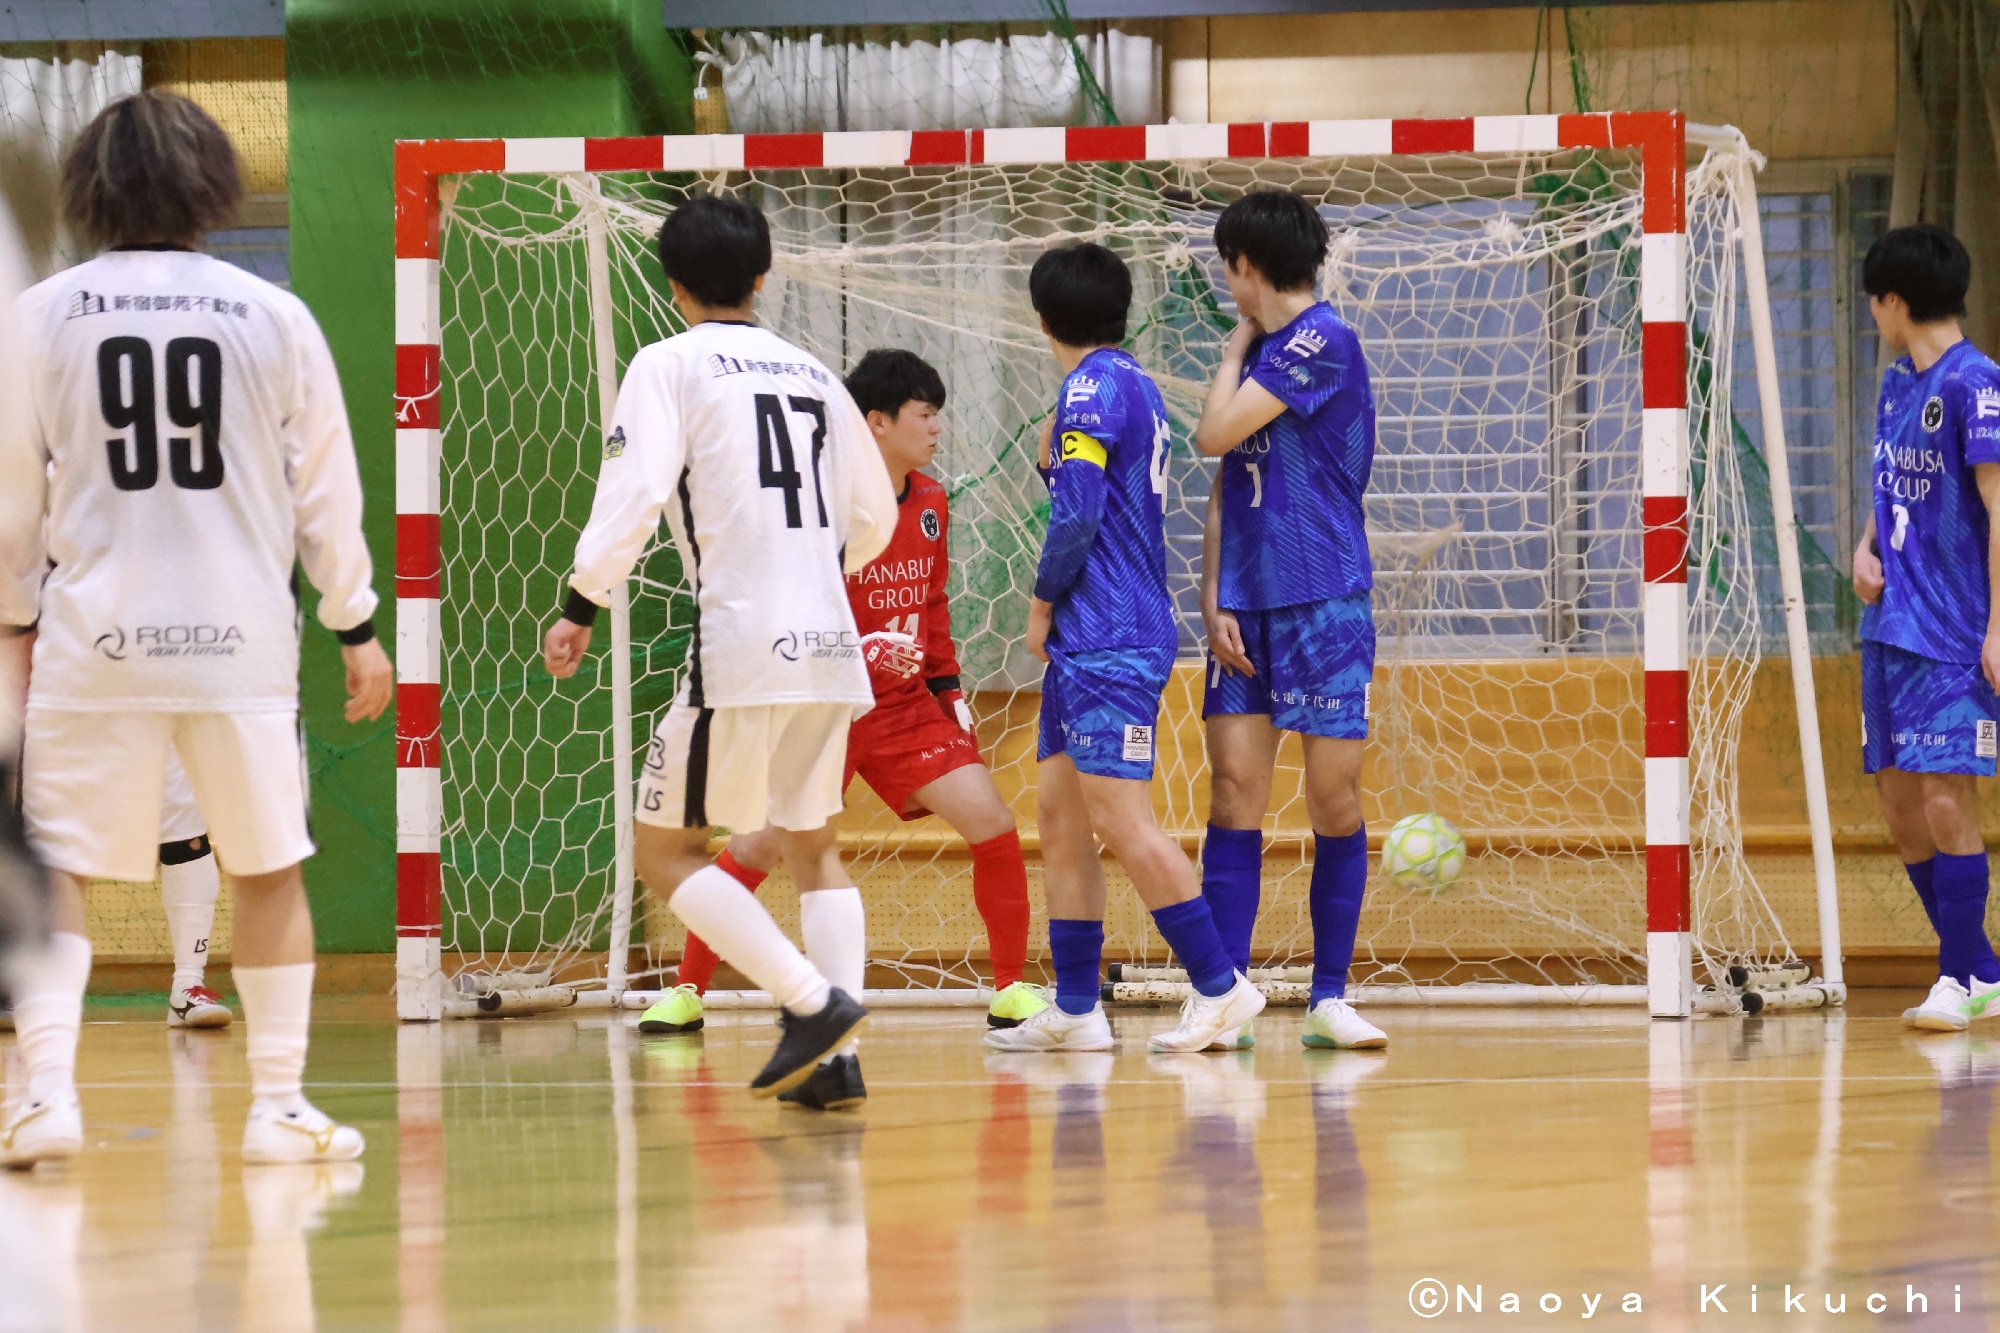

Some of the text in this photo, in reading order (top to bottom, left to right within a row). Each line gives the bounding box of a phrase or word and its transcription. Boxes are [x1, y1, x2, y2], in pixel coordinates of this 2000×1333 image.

[97, 336, 225, 491] 99
[1063, 434, 1077, 456] C
[754, 393, 828, 528] 47
[868, 583, 930, 609] GROU
[136, 625, 246, 645] RODA
